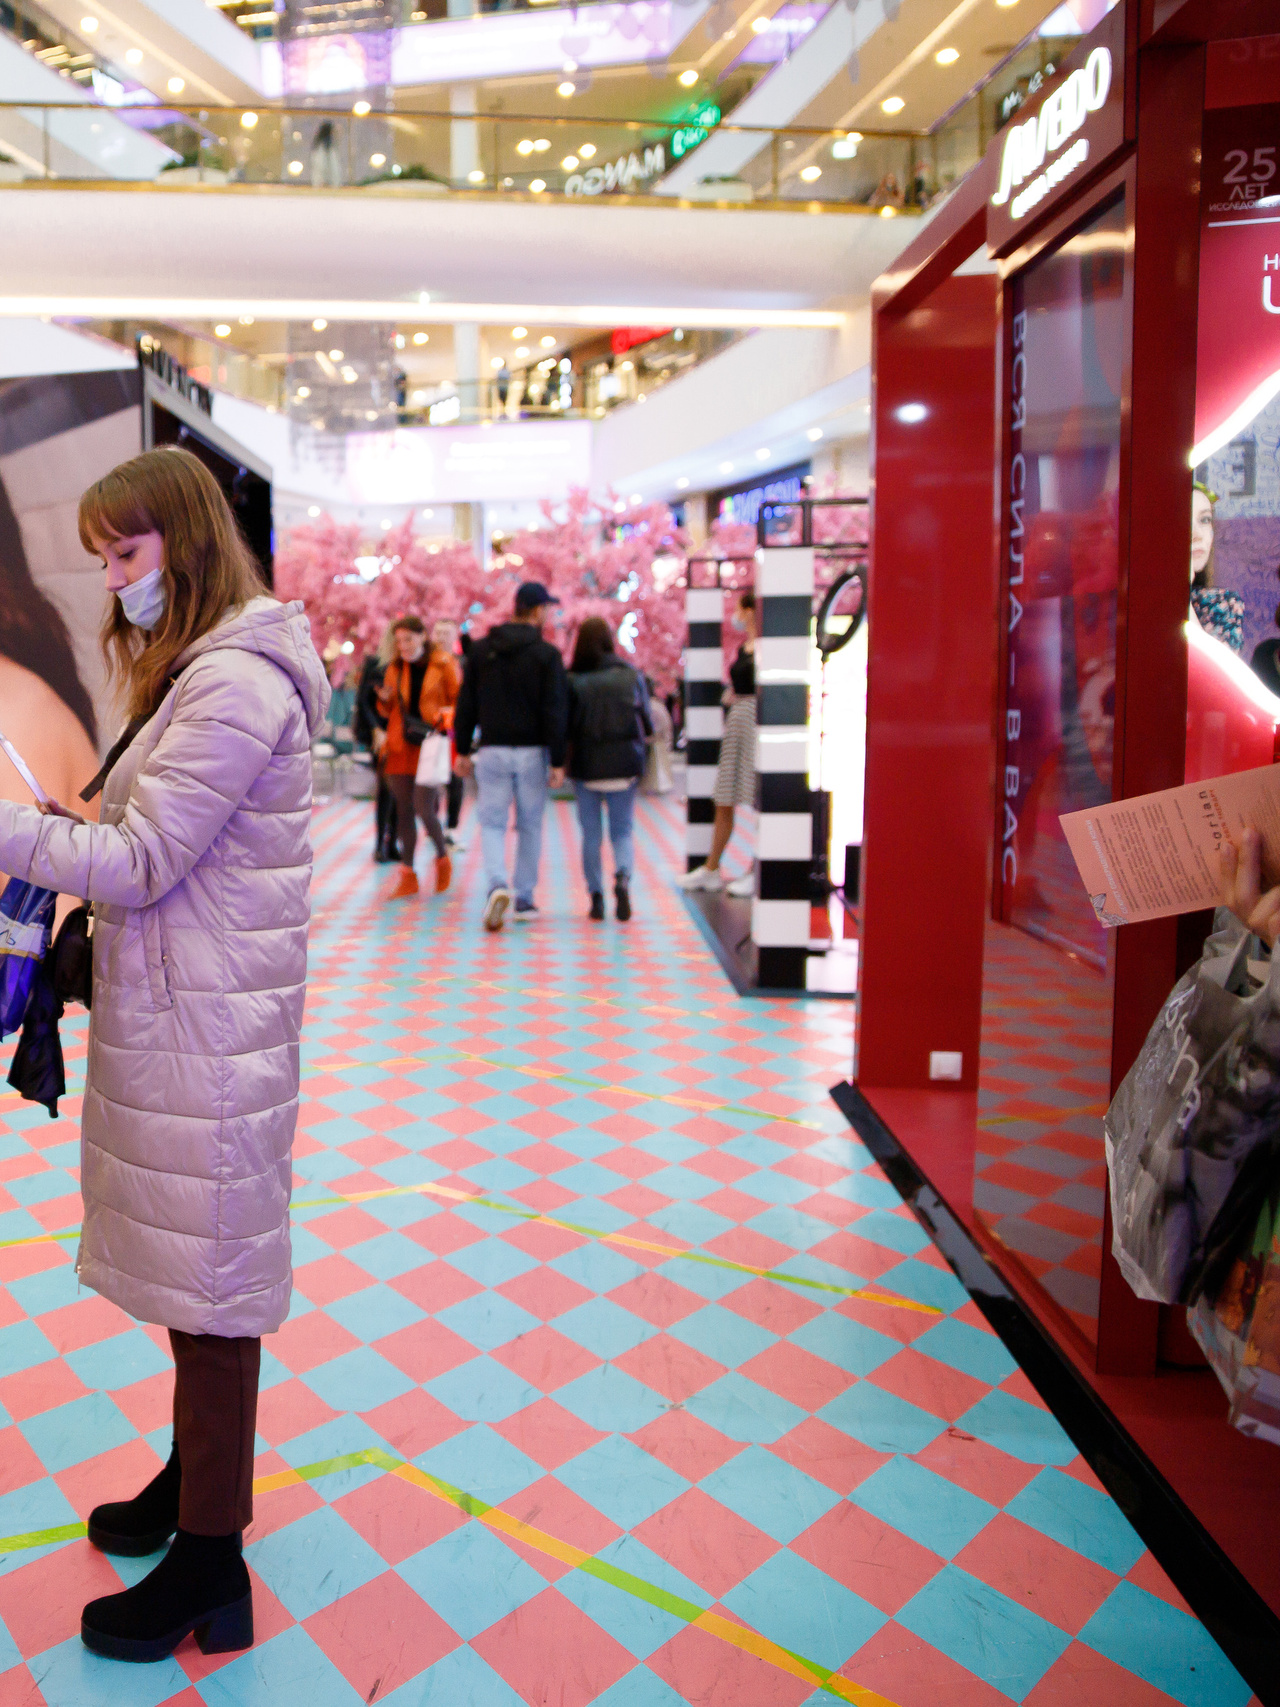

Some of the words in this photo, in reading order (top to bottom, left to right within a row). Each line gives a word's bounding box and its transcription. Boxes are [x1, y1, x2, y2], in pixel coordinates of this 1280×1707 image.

[1223, 147, 1277, 184] 25
[1229, 182, 1270, 201] ЛЕТ
[1009, 452, 1027, 633] СИЛА
[1002, 765, 1020, 886] ВАС
